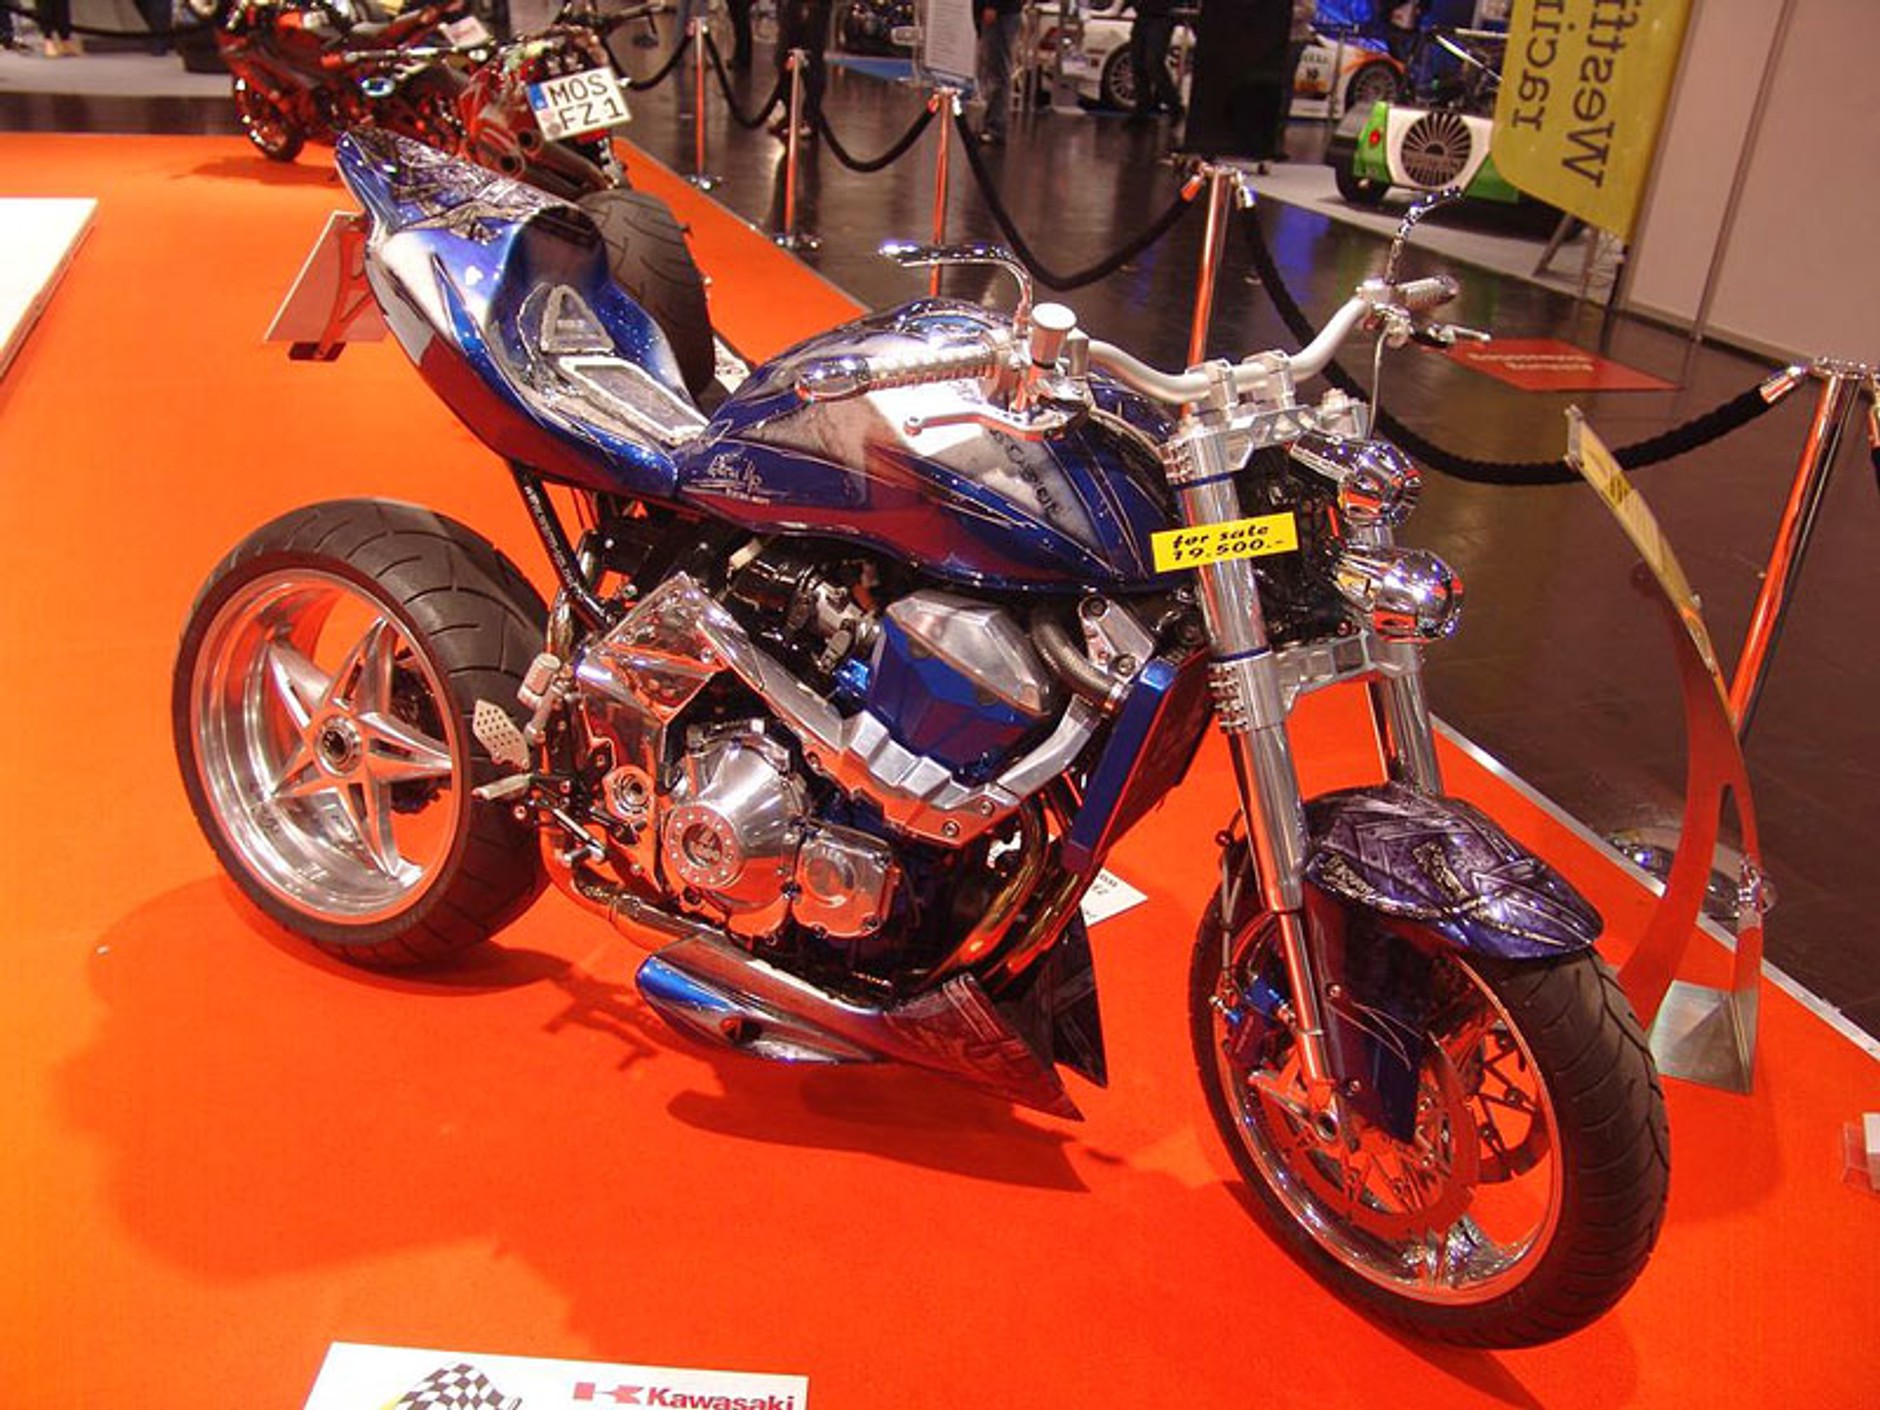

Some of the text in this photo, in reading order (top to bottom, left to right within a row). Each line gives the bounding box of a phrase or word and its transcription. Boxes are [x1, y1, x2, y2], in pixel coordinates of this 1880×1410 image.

[548, 73, 608, 107] MOS
[558, 97, 624, 131] FZ 1
[1172, 534, 1210, 549] for
[646, 1386, 795, 1410] Kawasaki
